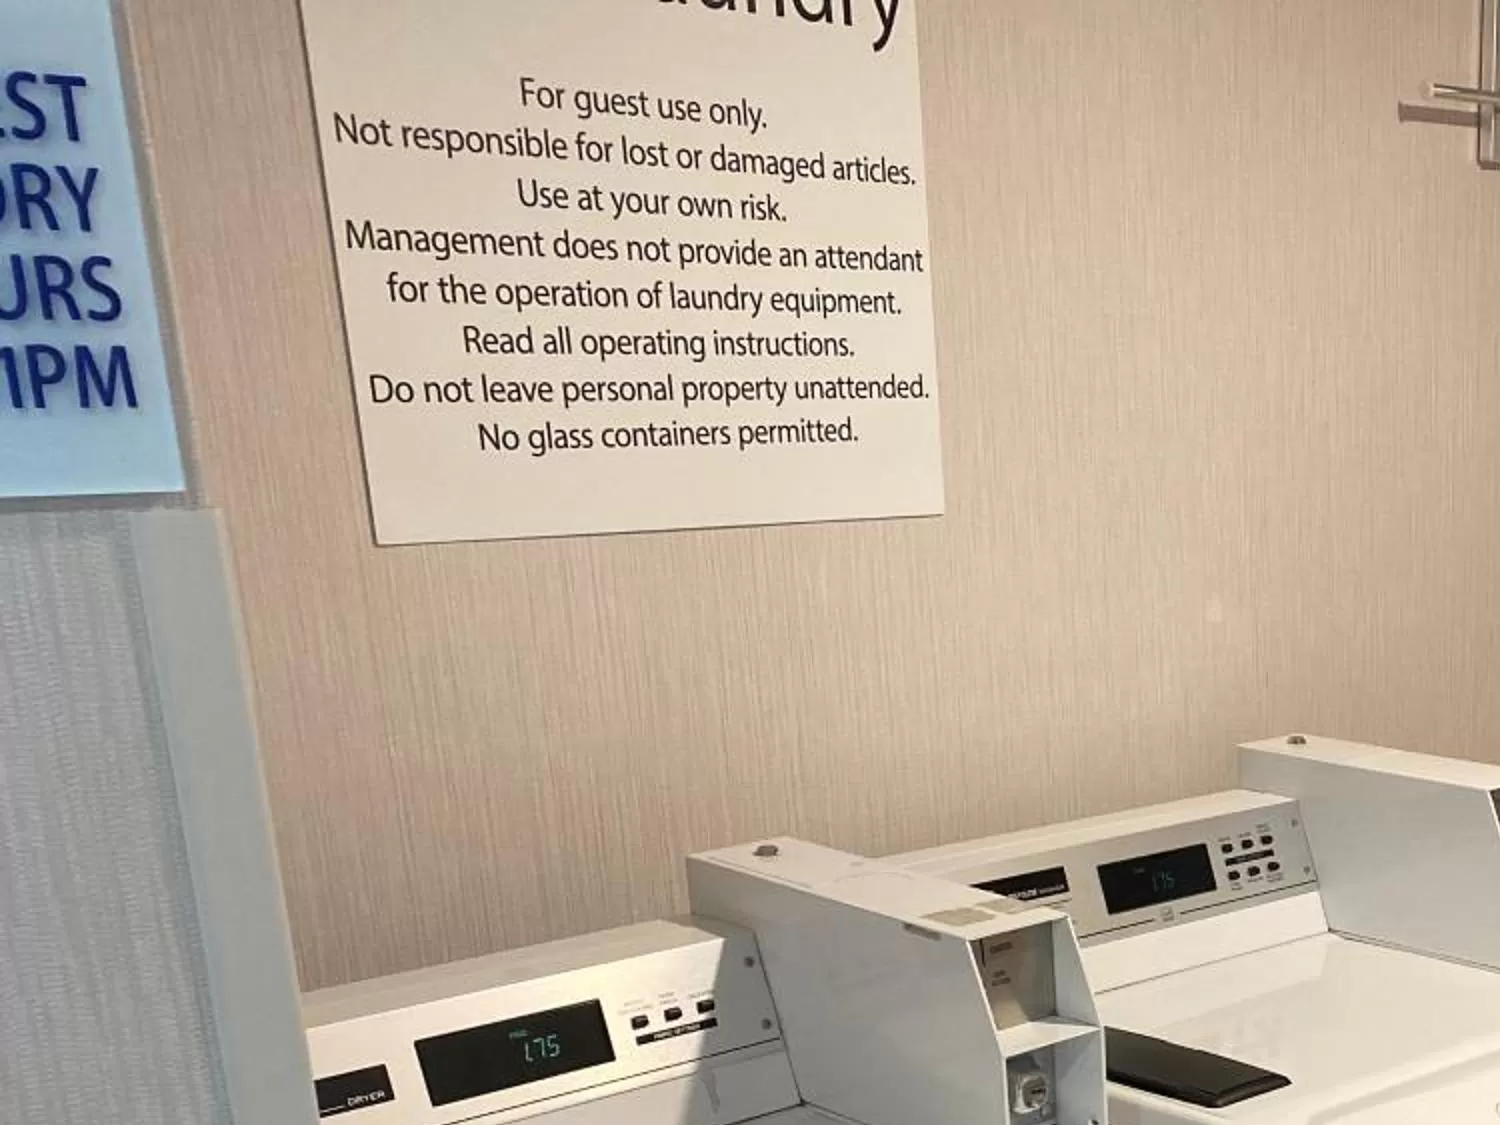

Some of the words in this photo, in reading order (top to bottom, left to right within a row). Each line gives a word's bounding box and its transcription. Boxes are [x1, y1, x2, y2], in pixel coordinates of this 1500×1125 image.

[0, 70, 88, 142] ST
[519, 76, 567, 111] For
[573, 89, 652, 121] guest
[656, 97, 703, 124] use
[708, 97, 768, 136] only.
[332, 111, 395, 148] Not
[400, 124, 570, 161] responsible
[573, 130, 615, 165] for
[620, 133, 671, 169] lost
[674, 147, 704, 172] or
[709, 142, 826, 185] damaged
[831, 155, 917, 186] articles.
[0, 163, 99, 232] RY
[516, 176, 571, 210] Use
[576, 184, 606, 213] at
[608, 190, 672, 222] your
[676, 194, 734, 220] own
[739, 192, 788, 223] risk.
[344, 218, 547, 262] Management
[552, 227, 620, 262] does
[625, 236, 673, 264] not
[677, 236, 773, 271] provide
[778, 246, 809, 269] an
[814, 243, 925, 273] attendant
[385, 270, 431, 304] for
[435, 272, 488, 306] the
[494, 279, 629, 315] operation
[636, 279, 664, 310] of
[668, 279, 764, 320] laundry
[769, 286, 902, 321] equipment.
[462, 324, 536, 355] Read
[542, 324, 573, 356] all
[579, 328, 707, 364] operating
[712, 328, 856, 358] instructions.
[368, 373, 416, 404] Do
[422, 376, 476, 404] not
[479, 371, 555, 404] leave
[560, 372, 675, 413] personal
[680, 375, 789, 410] property
[793, 372, 930, 401] unattended.
[477, 422, 521, 452] No
[527, 419, 595, 458] glass
[600, 419, 732, 449] containers
[737, 415, 859, 452] permitted.
